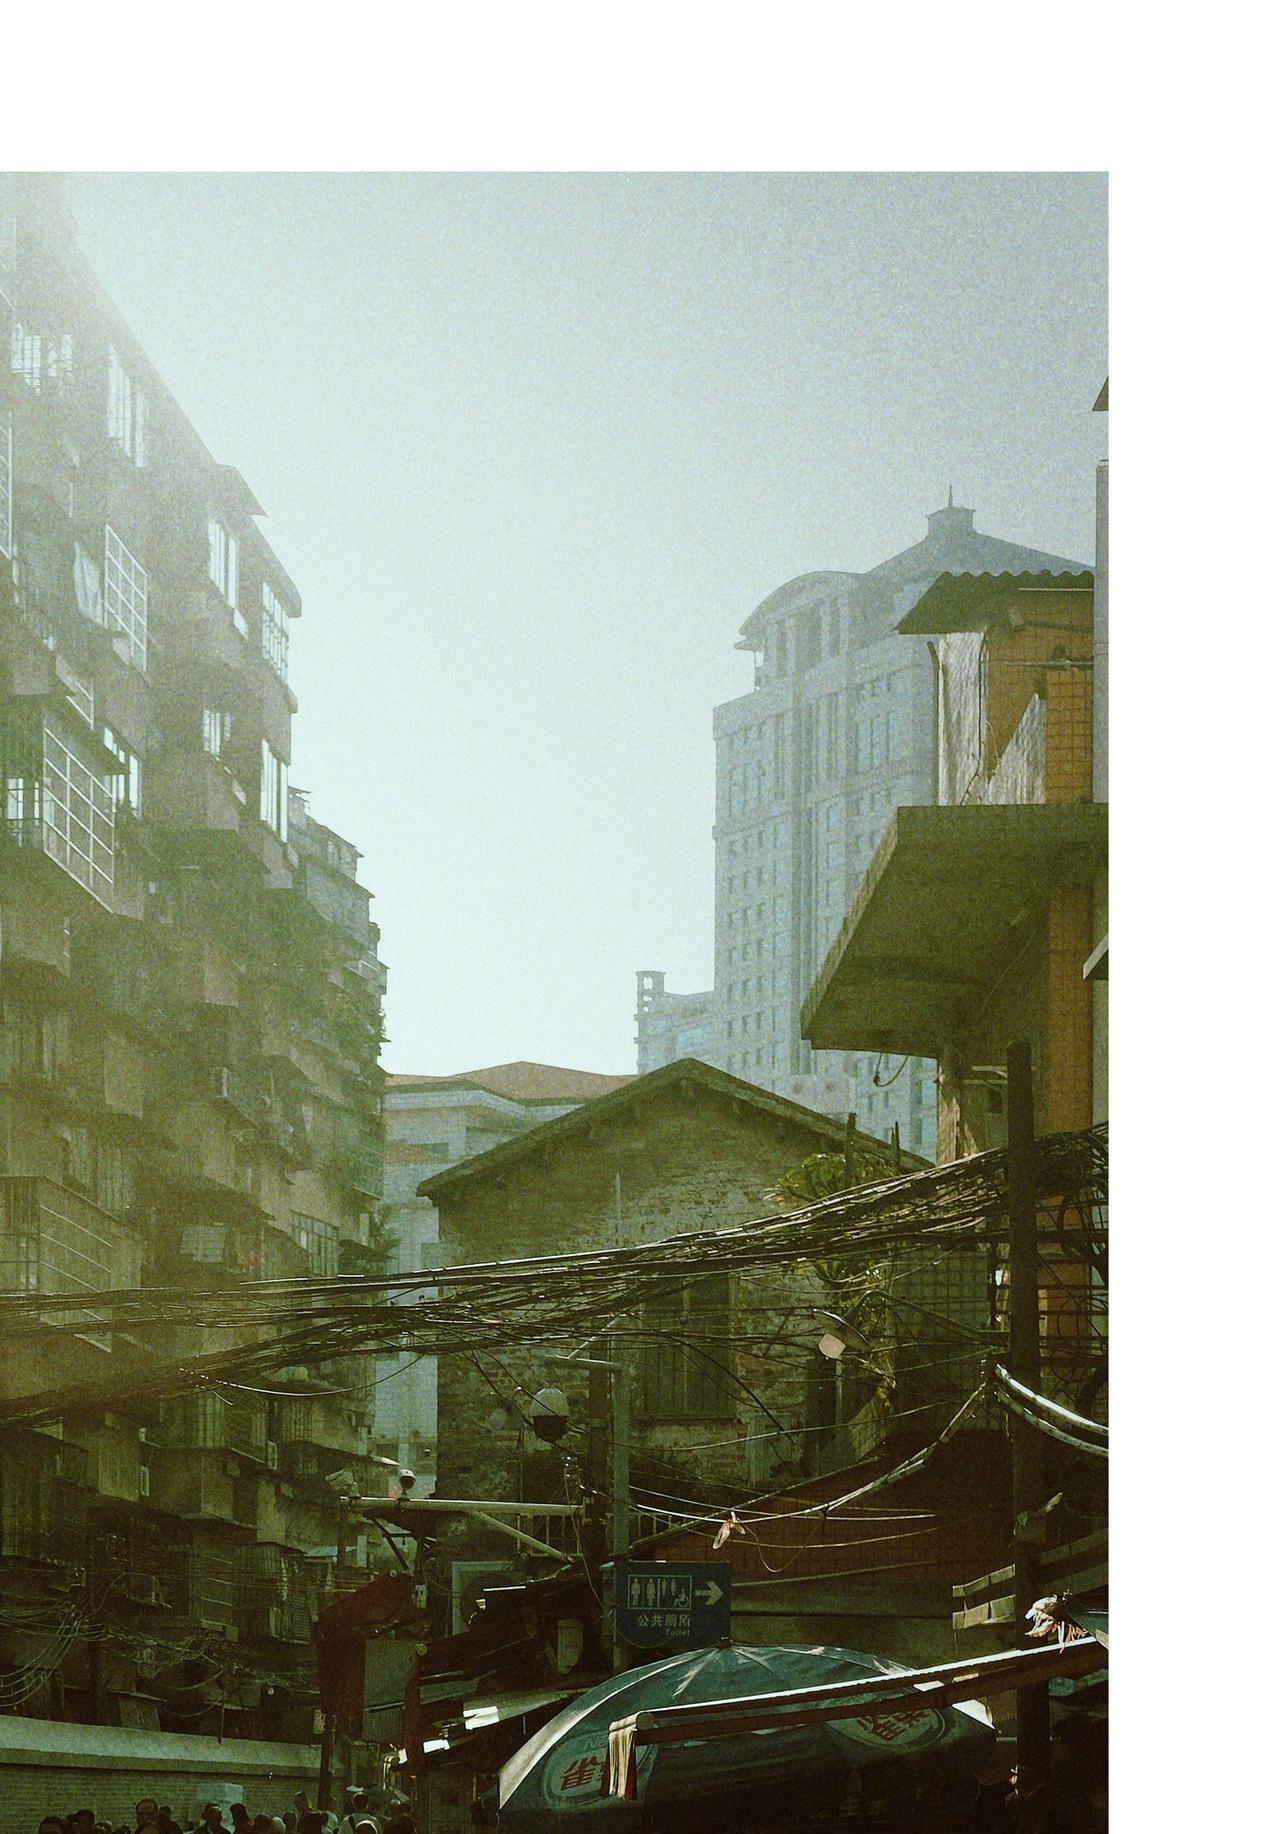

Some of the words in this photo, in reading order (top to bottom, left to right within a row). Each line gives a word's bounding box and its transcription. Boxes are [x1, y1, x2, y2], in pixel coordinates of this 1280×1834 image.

[637, 1613, 691, 1628] 公共厕所
[560, 1755, 608, 1791] 雀
